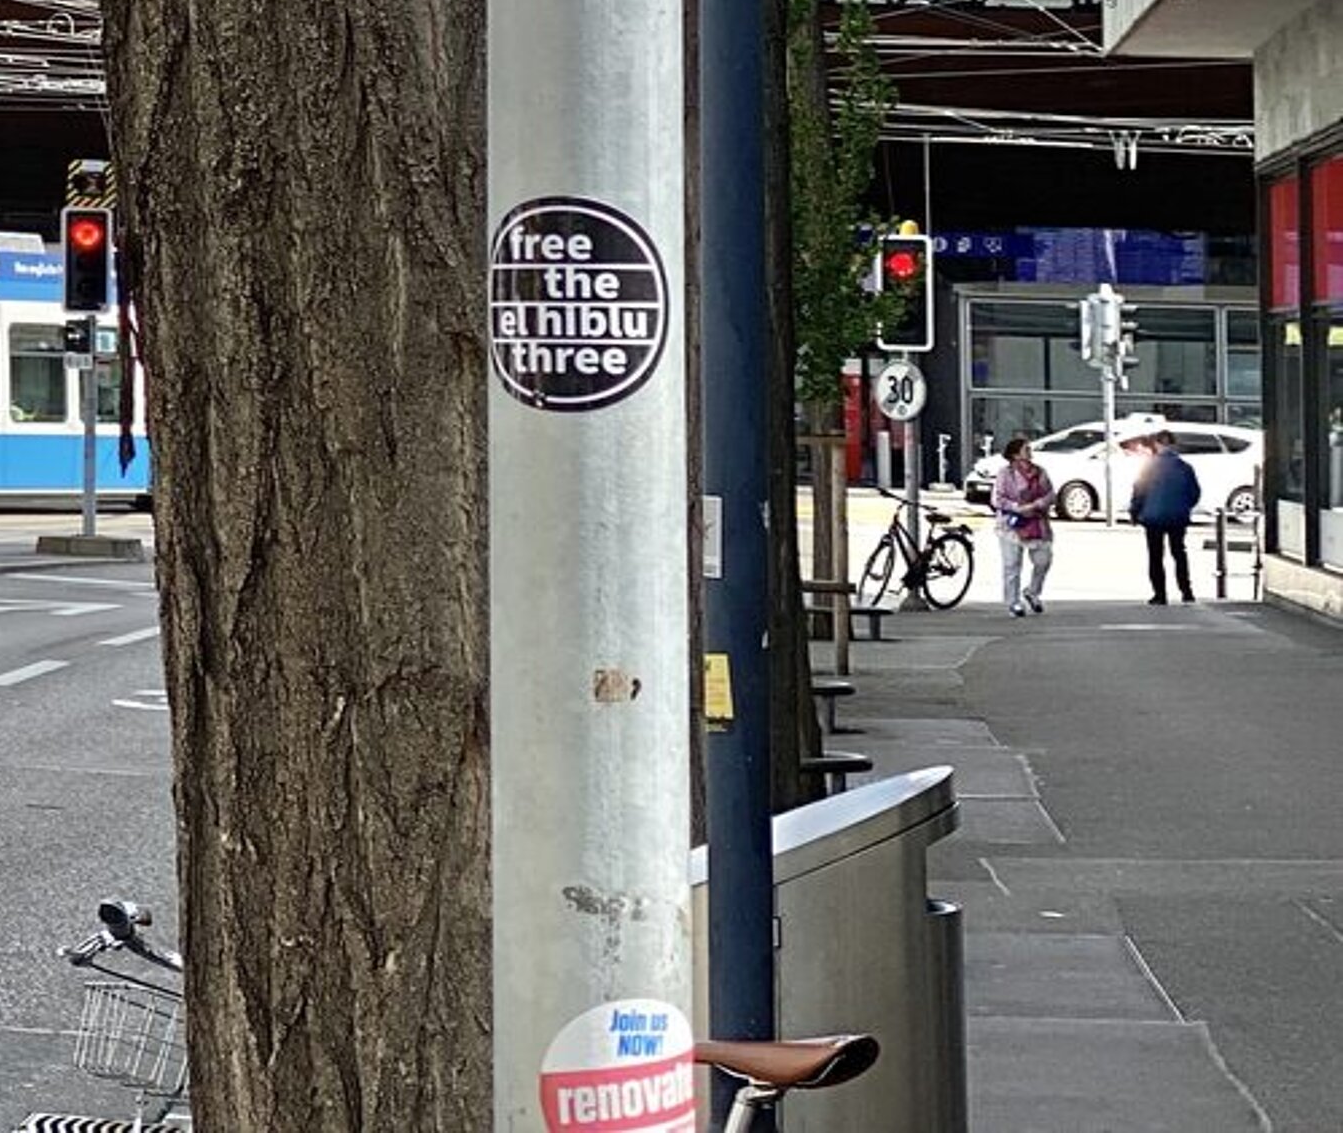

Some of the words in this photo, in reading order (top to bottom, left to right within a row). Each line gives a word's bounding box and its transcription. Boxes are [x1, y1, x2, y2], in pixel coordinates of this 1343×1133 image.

[509, 226, 593, 260] free
[544, 268, 620, 298] the
[499, 305, 528, 336] el
[511, 343, 627, 375] three
[887, 375, 914, 404] 30
[610, 1009, 647, 1032] Join
[650, 1013, 668, 1031] us
[617, 1035, 663, 1057] NOW!
[557, 1062, 694, 1125] renovat
